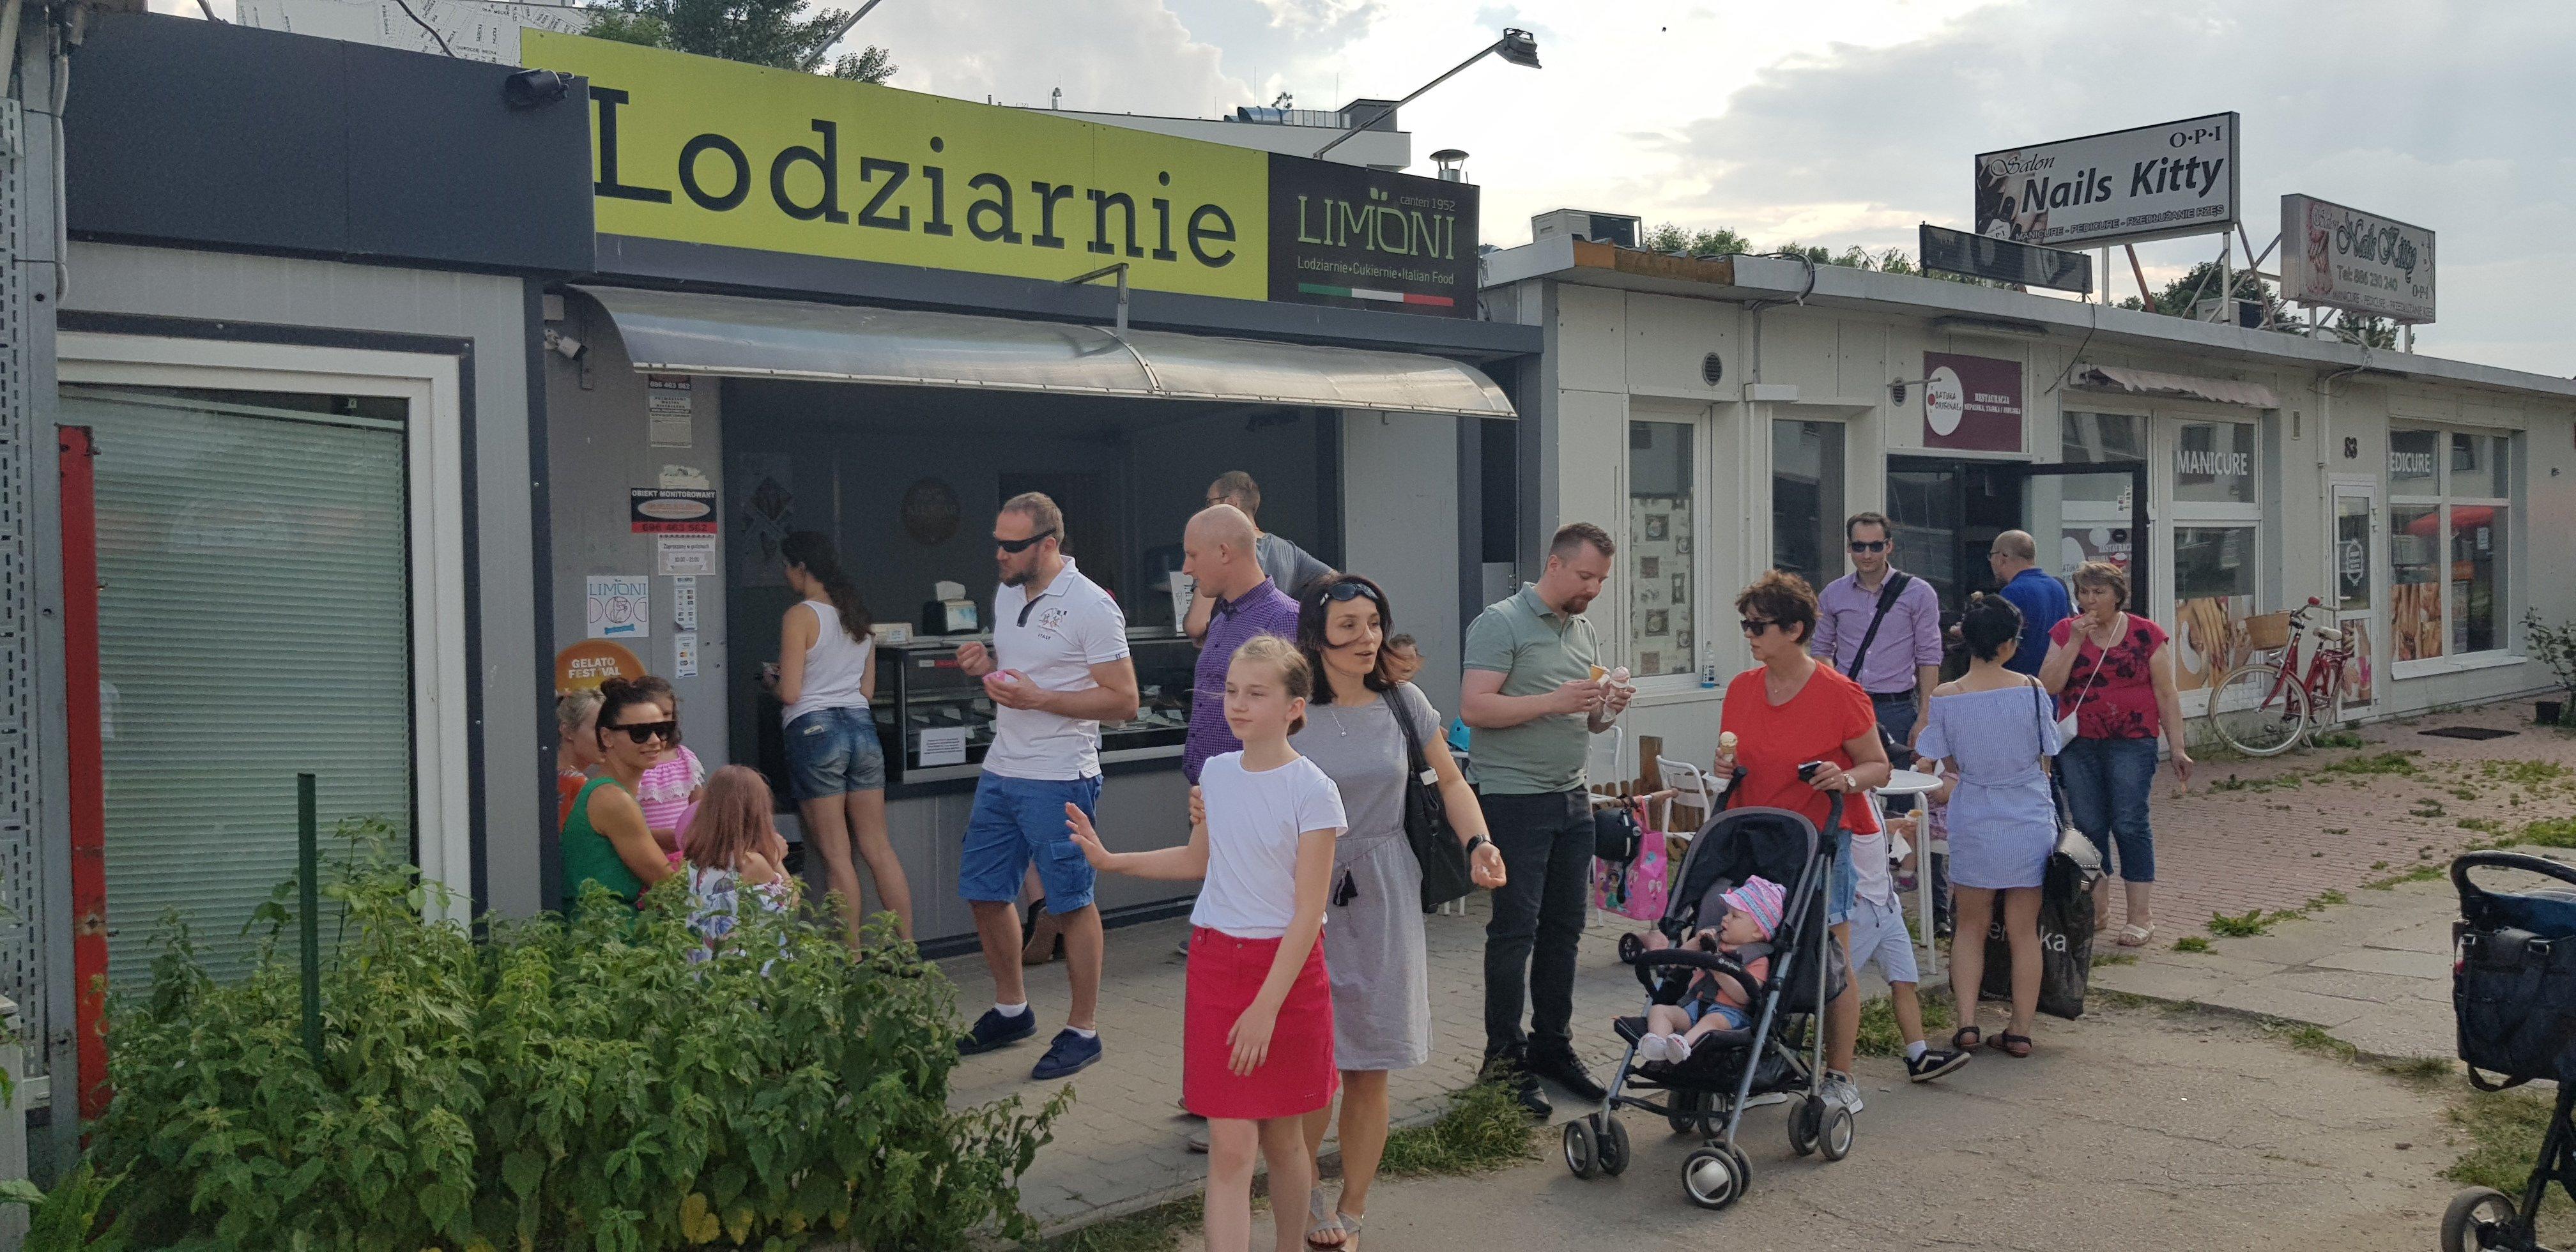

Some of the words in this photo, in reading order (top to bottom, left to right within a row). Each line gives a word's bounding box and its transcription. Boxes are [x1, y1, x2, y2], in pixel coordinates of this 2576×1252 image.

[1991, 153, 2055, 176] Salon
[590, 86, 1236, 268] Lodziarnie
[2021, 167, 2112, 213] Nails
[2129, 155, 2223, 198] Kitty
[1432, 198, 1455, 211] 1952
[2016, 227, 2064, 241] MANICURE
[2070, 218, 2119, 234] PEDICURE
[1298, 256, 1348, 274] Lodziarnie
[1353, 262, 1398, 279] Cukiernie
[1402, 268, 1430, 282] Italian
[1432, 271, 1454, 285] Food
[2176, 450, 2248, 475] MANICURE
[2390, 452, 2430, 473] EDICURE
[659, 490, 716, 498] MONITOROWANY
[571, 657, 616, 669] GELATO
